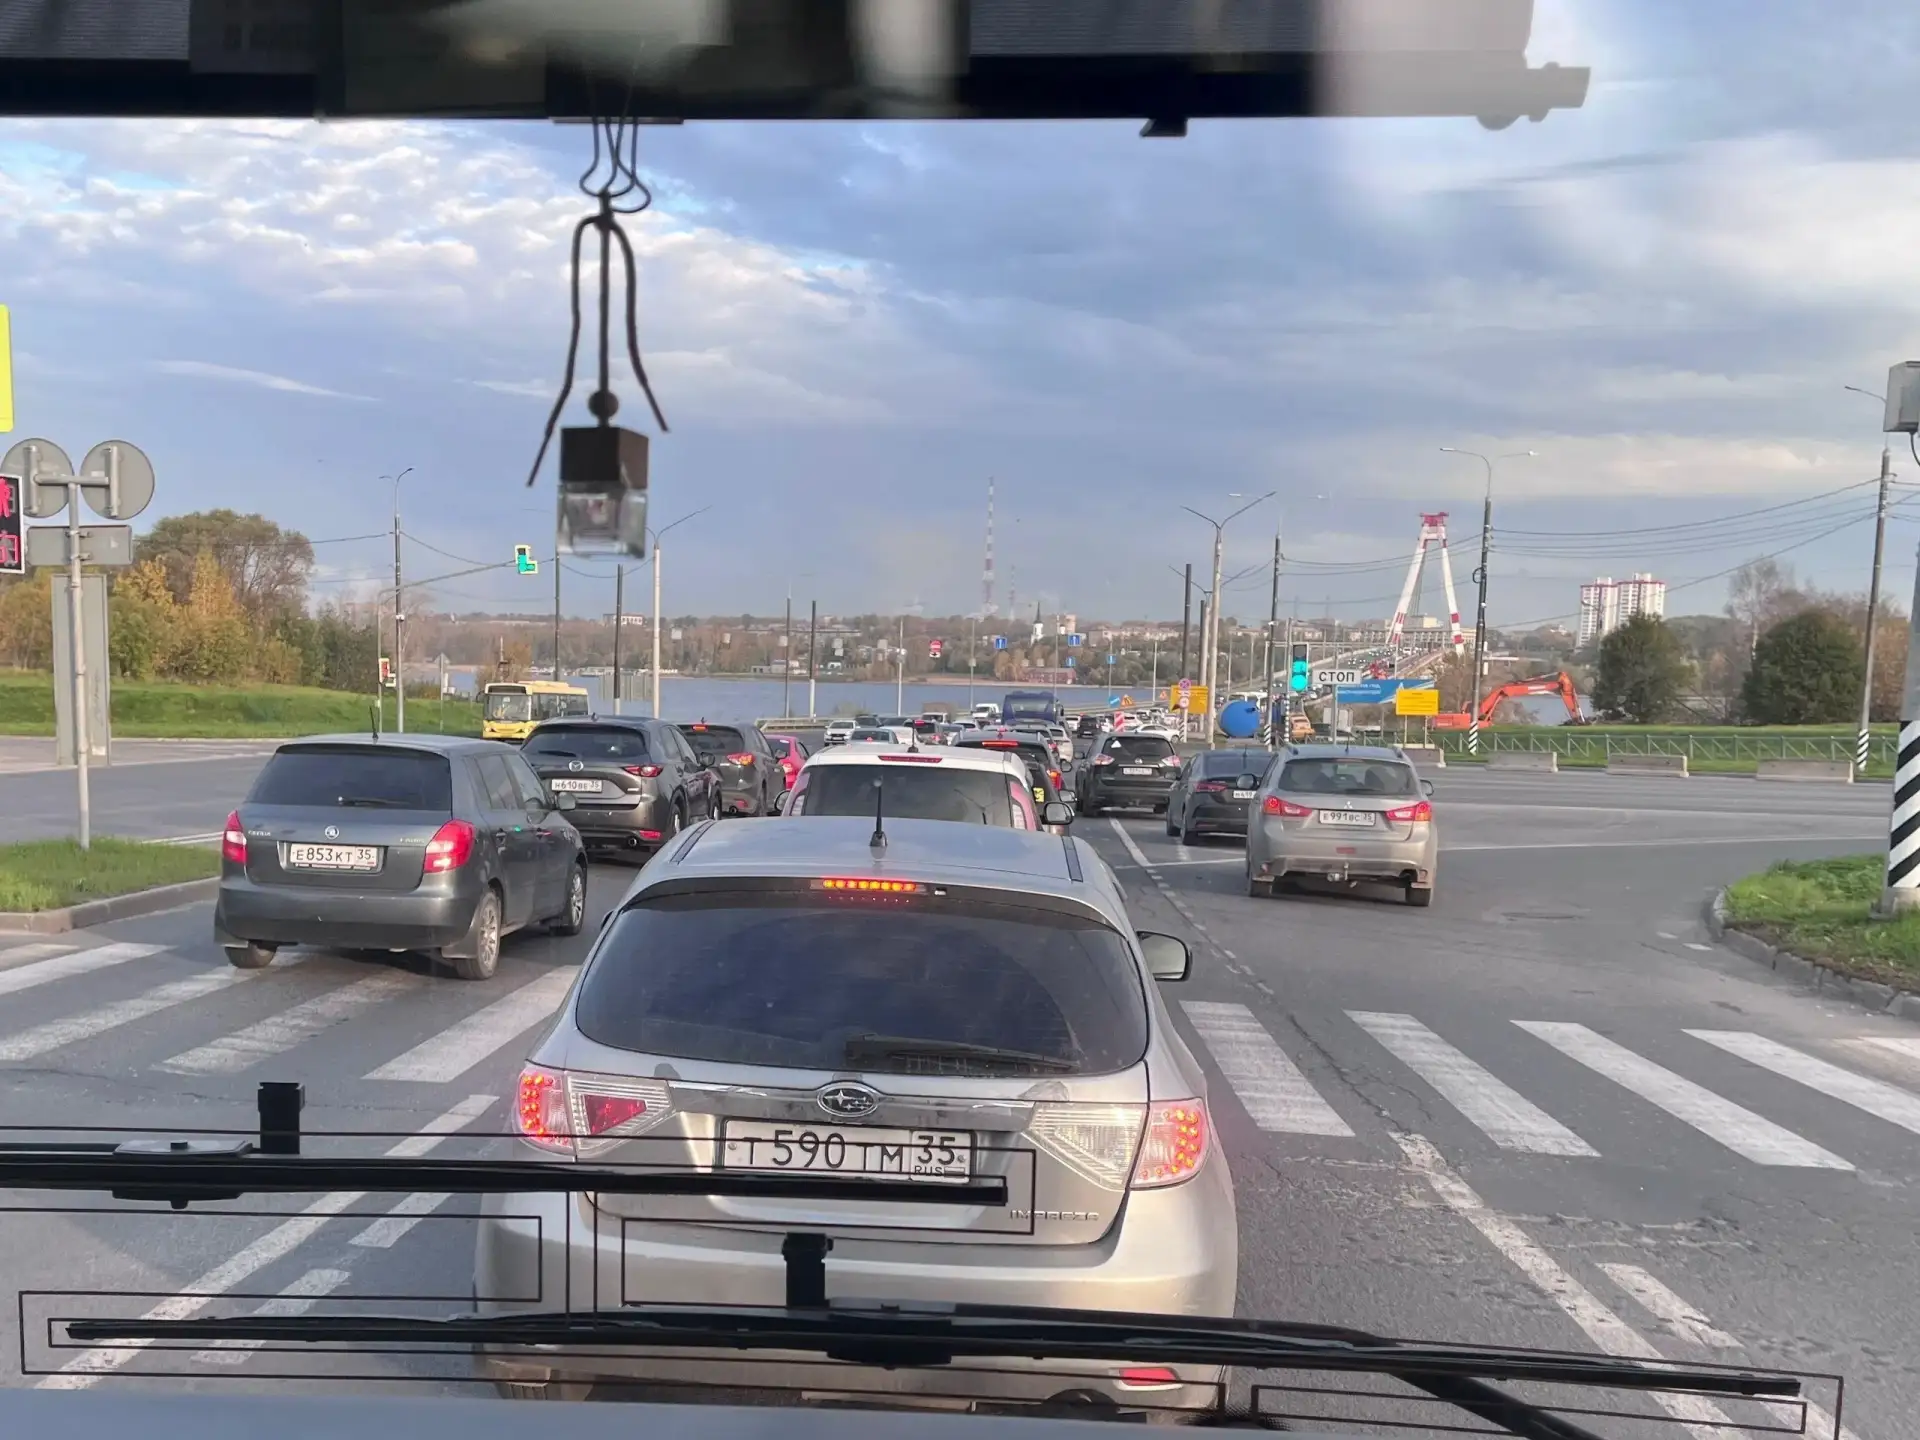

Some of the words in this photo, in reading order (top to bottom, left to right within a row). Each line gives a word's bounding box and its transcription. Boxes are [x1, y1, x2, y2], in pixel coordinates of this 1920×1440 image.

[1318, 671, 1355, 682] СТОП
[357, 848, 372, 860] 35
[917, 1134, 956, 1165] 35
[914, 1165, 943, 1177] RUS
